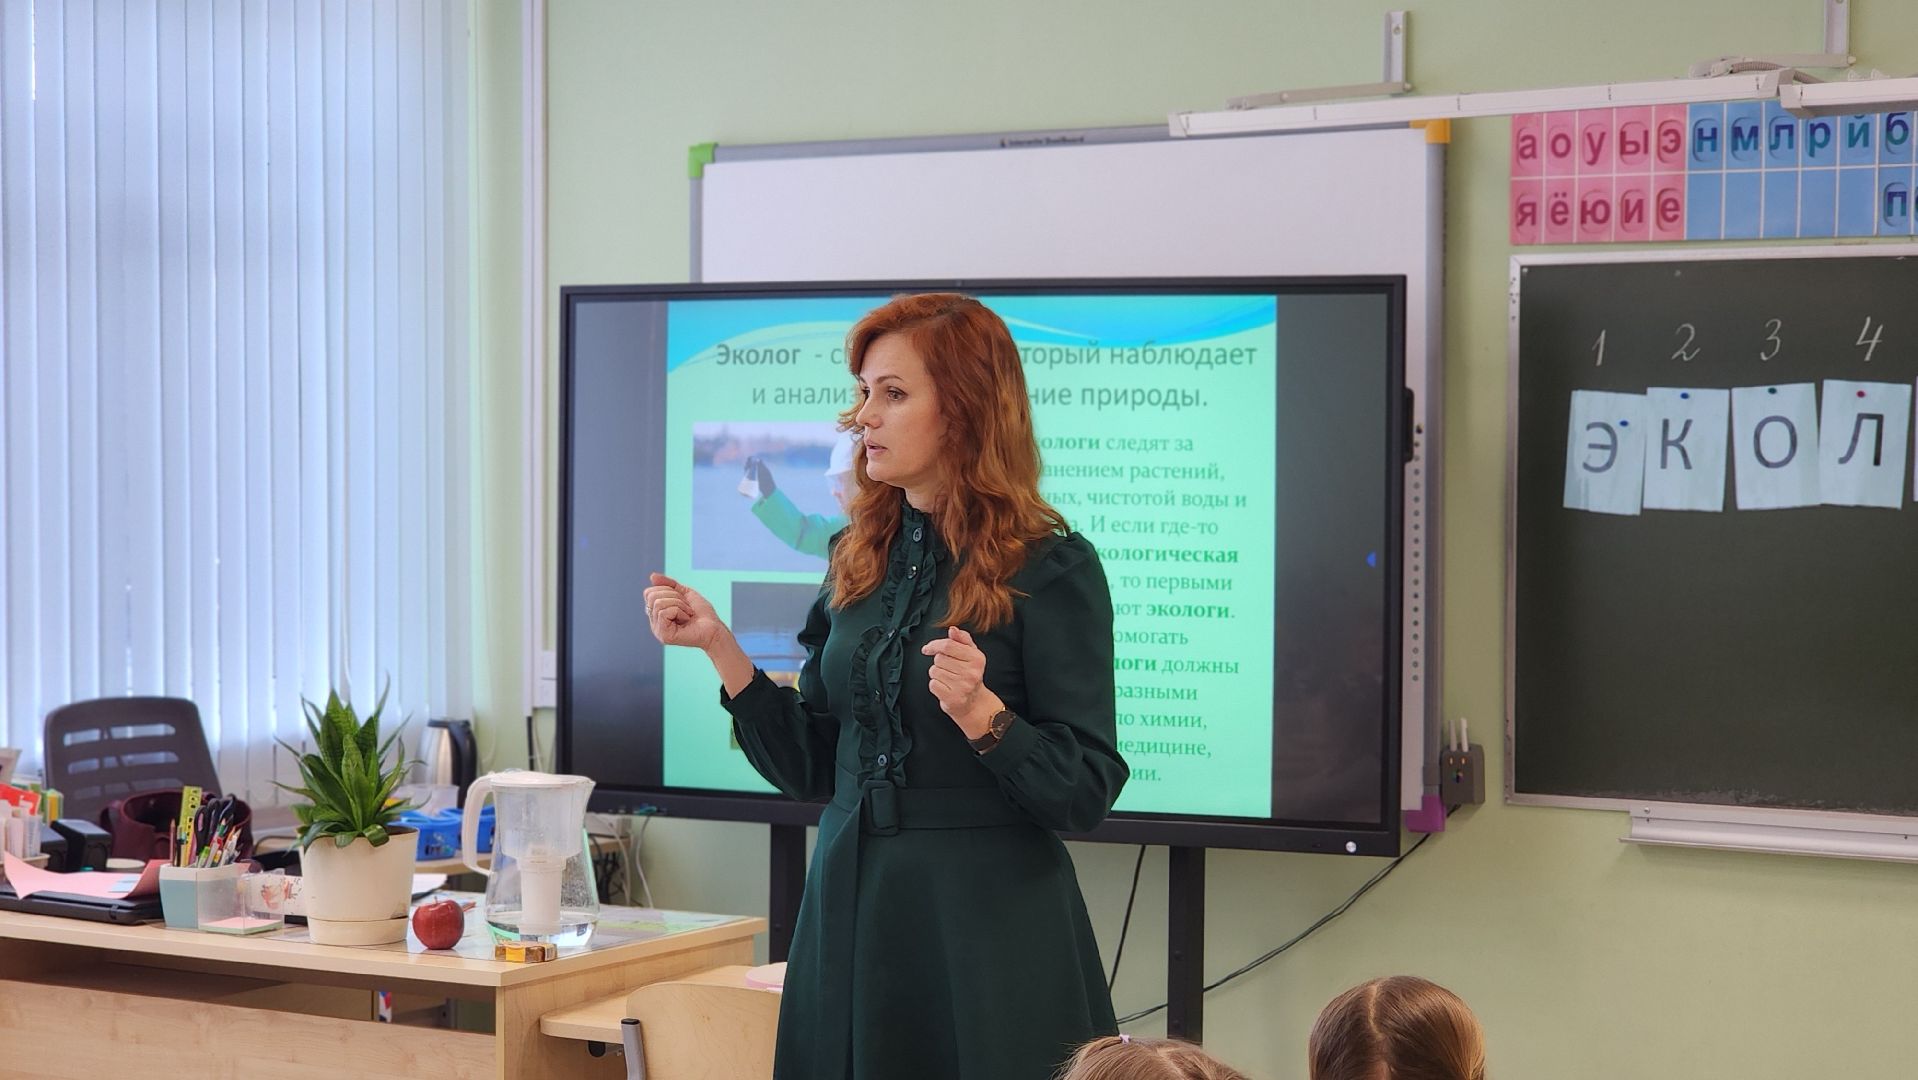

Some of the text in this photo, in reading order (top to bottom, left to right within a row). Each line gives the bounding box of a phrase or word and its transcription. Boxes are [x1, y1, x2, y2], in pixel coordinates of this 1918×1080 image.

[1518, 112, 1909, 166] а о у ы э н м л р й б
[1516, 202, 1537, 227] я
[1550, 193, 1569, 225] ё
[1580, 199, 1611, 225] ю
[1624, 198, 1644, 224] и
[1660, 196, 1680, 223] е
[1886, 191, 1907, 217] п
[1592, 316, 1884, 366] 1 2 3 4
[715, 343, 802, 366] Эколог
[1020, 340, 1101, 370] торый
[1110, 340, 1257, 371] наблюдает
[752, 387, 766, 404] и
[1081, 388, 1208, 411] природы.
[1105, 437, 1169, 453] следят
[1174, 439, 1194, 452] за
[1582, 412, 1884, 473] Э К О Л
[1129, 463, 1225, 483] растений,
[1086, 489, 1176, 507] чистотой
[1181, 490, 1229, 509] воды
[1234, 495, 1247, 508] и
[1090, 515, 1105, 533] И
[1110, 518, 1154, 534] если
[1159, 518, 1219, 537] где-то
[1098, 547, 1239, 563] кологическая
[1120, 575, 1141, 590] то
[1146, 575, 1233, 595] первыми
[1146, 603, 1236, 619] экологи.
[1161, 659, 1240, 675] должны
[1139, 713, 1208, 730] химии,
